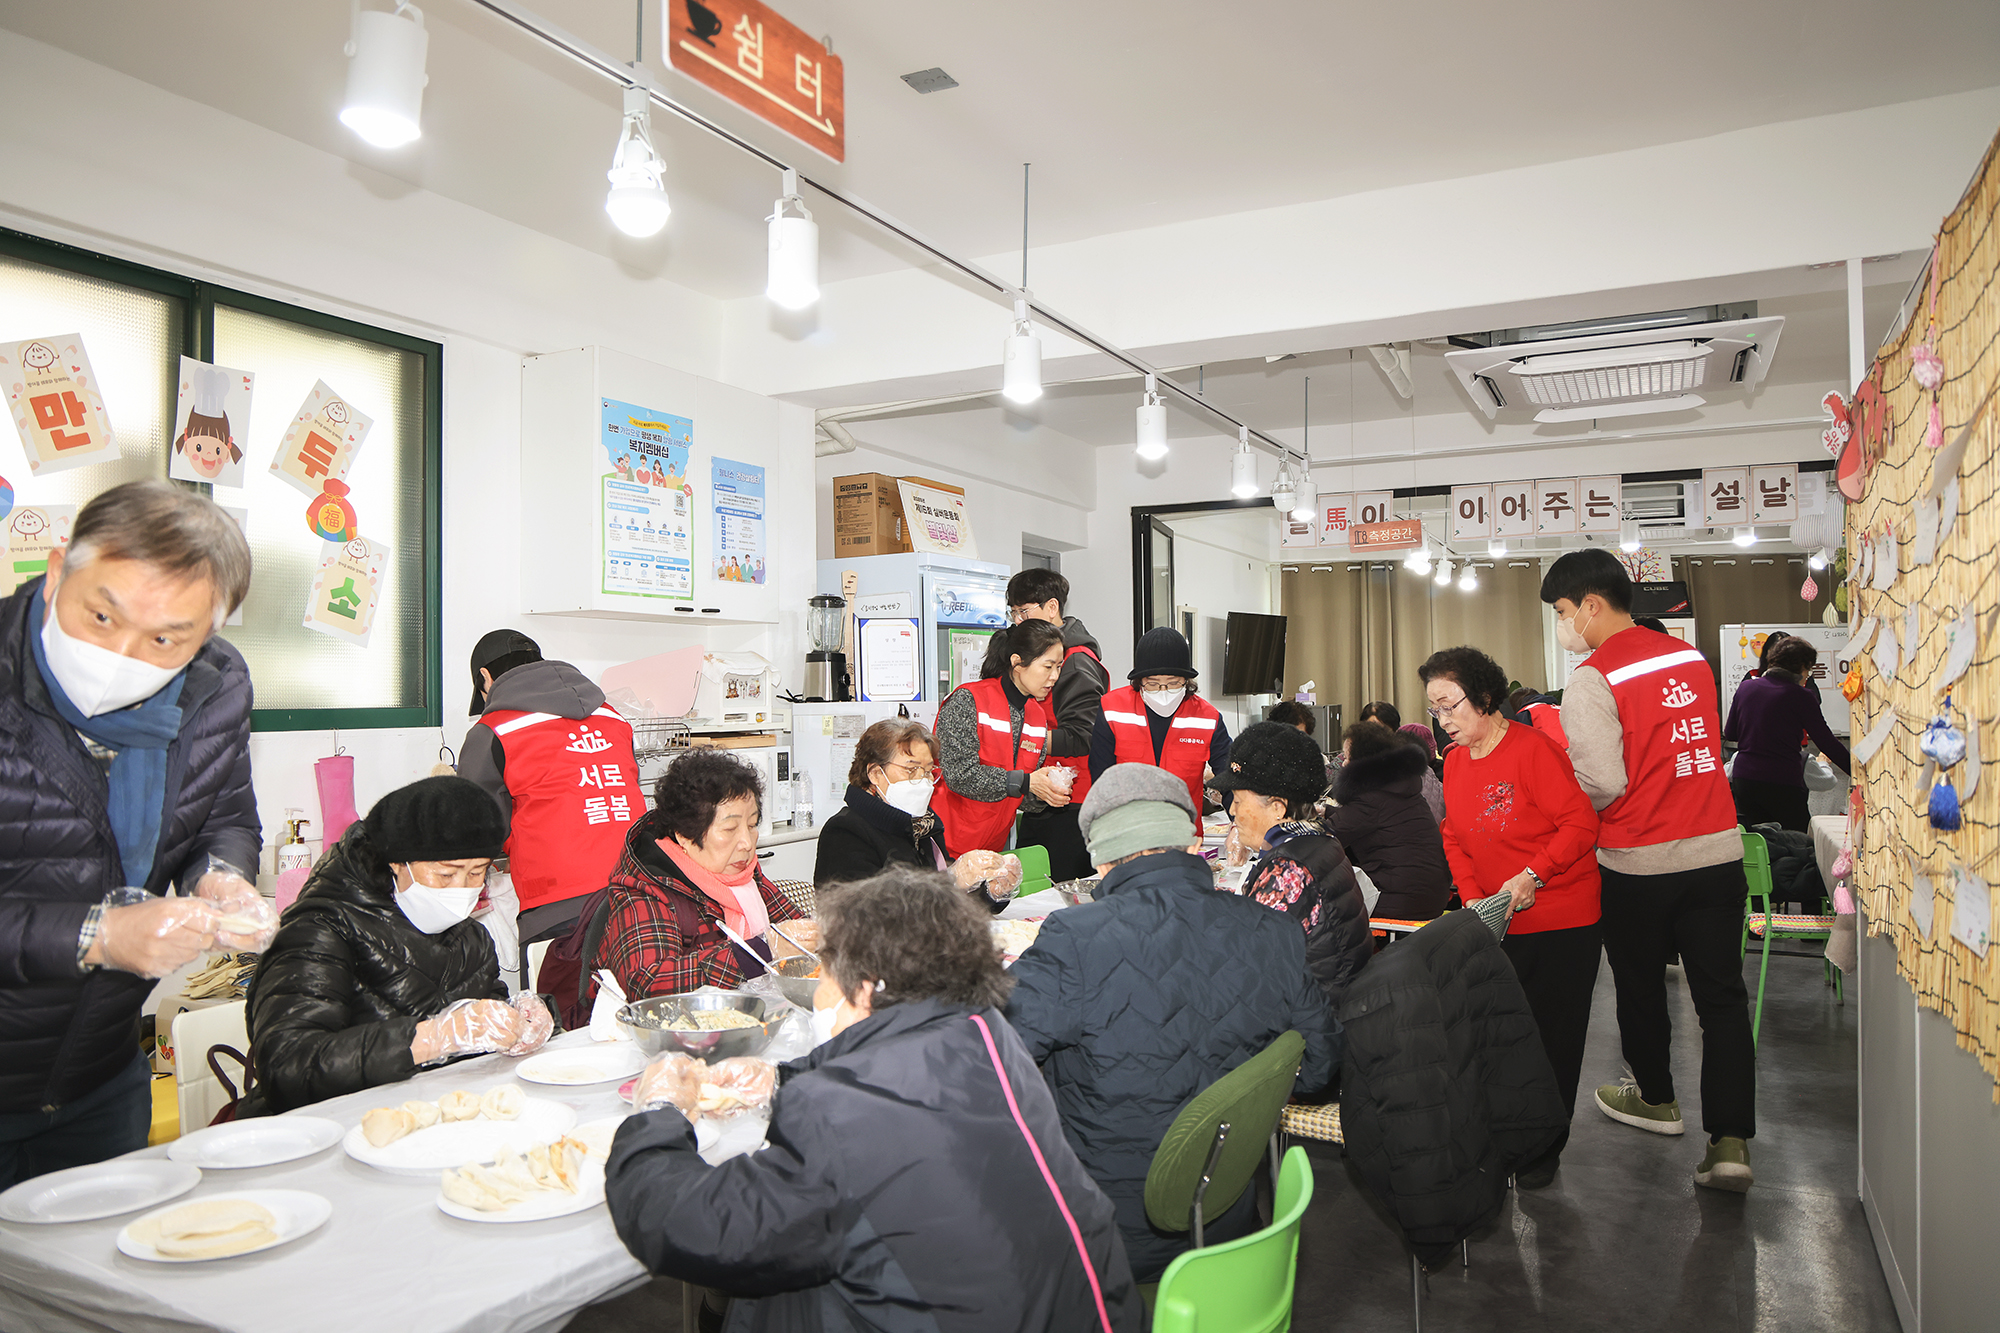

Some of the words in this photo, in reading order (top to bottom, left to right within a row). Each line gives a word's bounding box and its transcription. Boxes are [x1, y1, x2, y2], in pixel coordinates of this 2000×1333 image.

[29, 390, 91, 451] 만
[297, 430, 338, 479] 두
[629, 438, 669, 459] 복지멤버십
[1459, 489, 1614, 524] 이어주는
[1711, 477, 1791, 511] 설날
[323, 508, 341, 528] 福
[1369, 527, 1413, 541] 측정공간
[327, 576, 361, 620] 소
[1670, 716, 1708, 744] 서로
[578, 764, 626, 790] 서로
[1675, 746, 1716, 778] 돌봄
[583, 794, 631, 825] 돌봄
